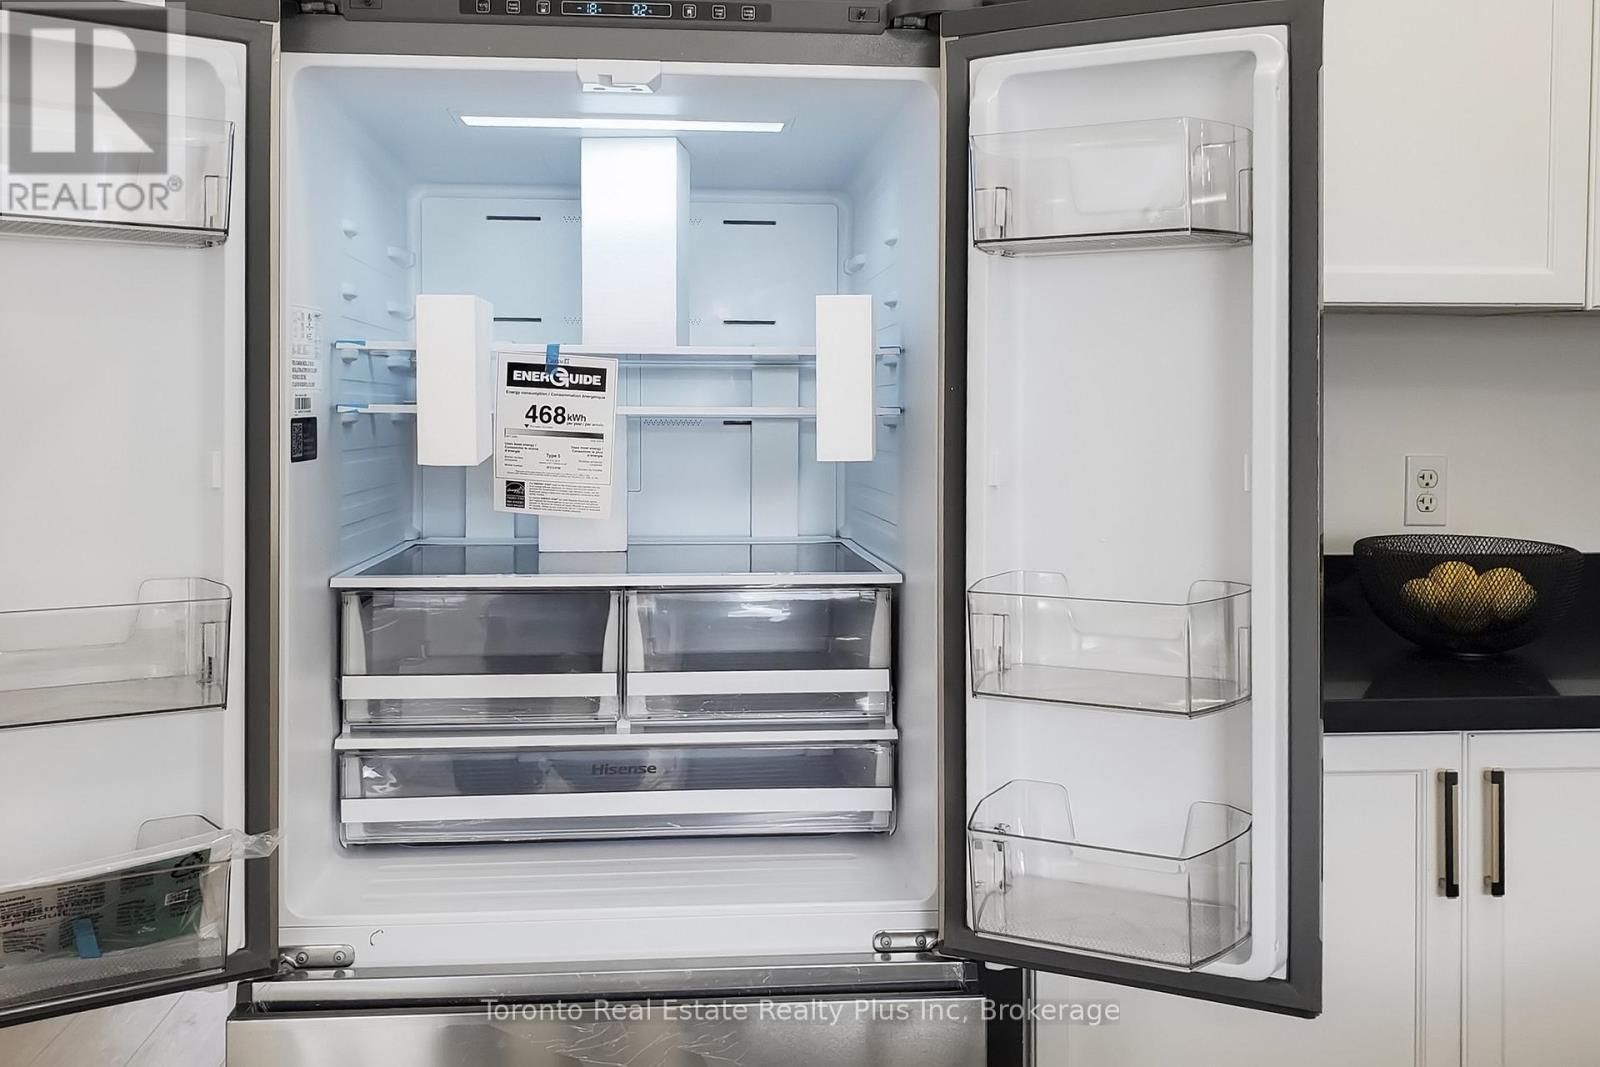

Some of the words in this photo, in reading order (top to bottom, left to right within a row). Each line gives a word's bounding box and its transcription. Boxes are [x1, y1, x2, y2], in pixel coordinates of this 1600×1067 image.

[512, 367, 602, 388] ENERGUIDE
[525, 404, 566, 425] 468
[567, 413, 587, 422] kWh
[591, 763, 657, 776] Hisense
